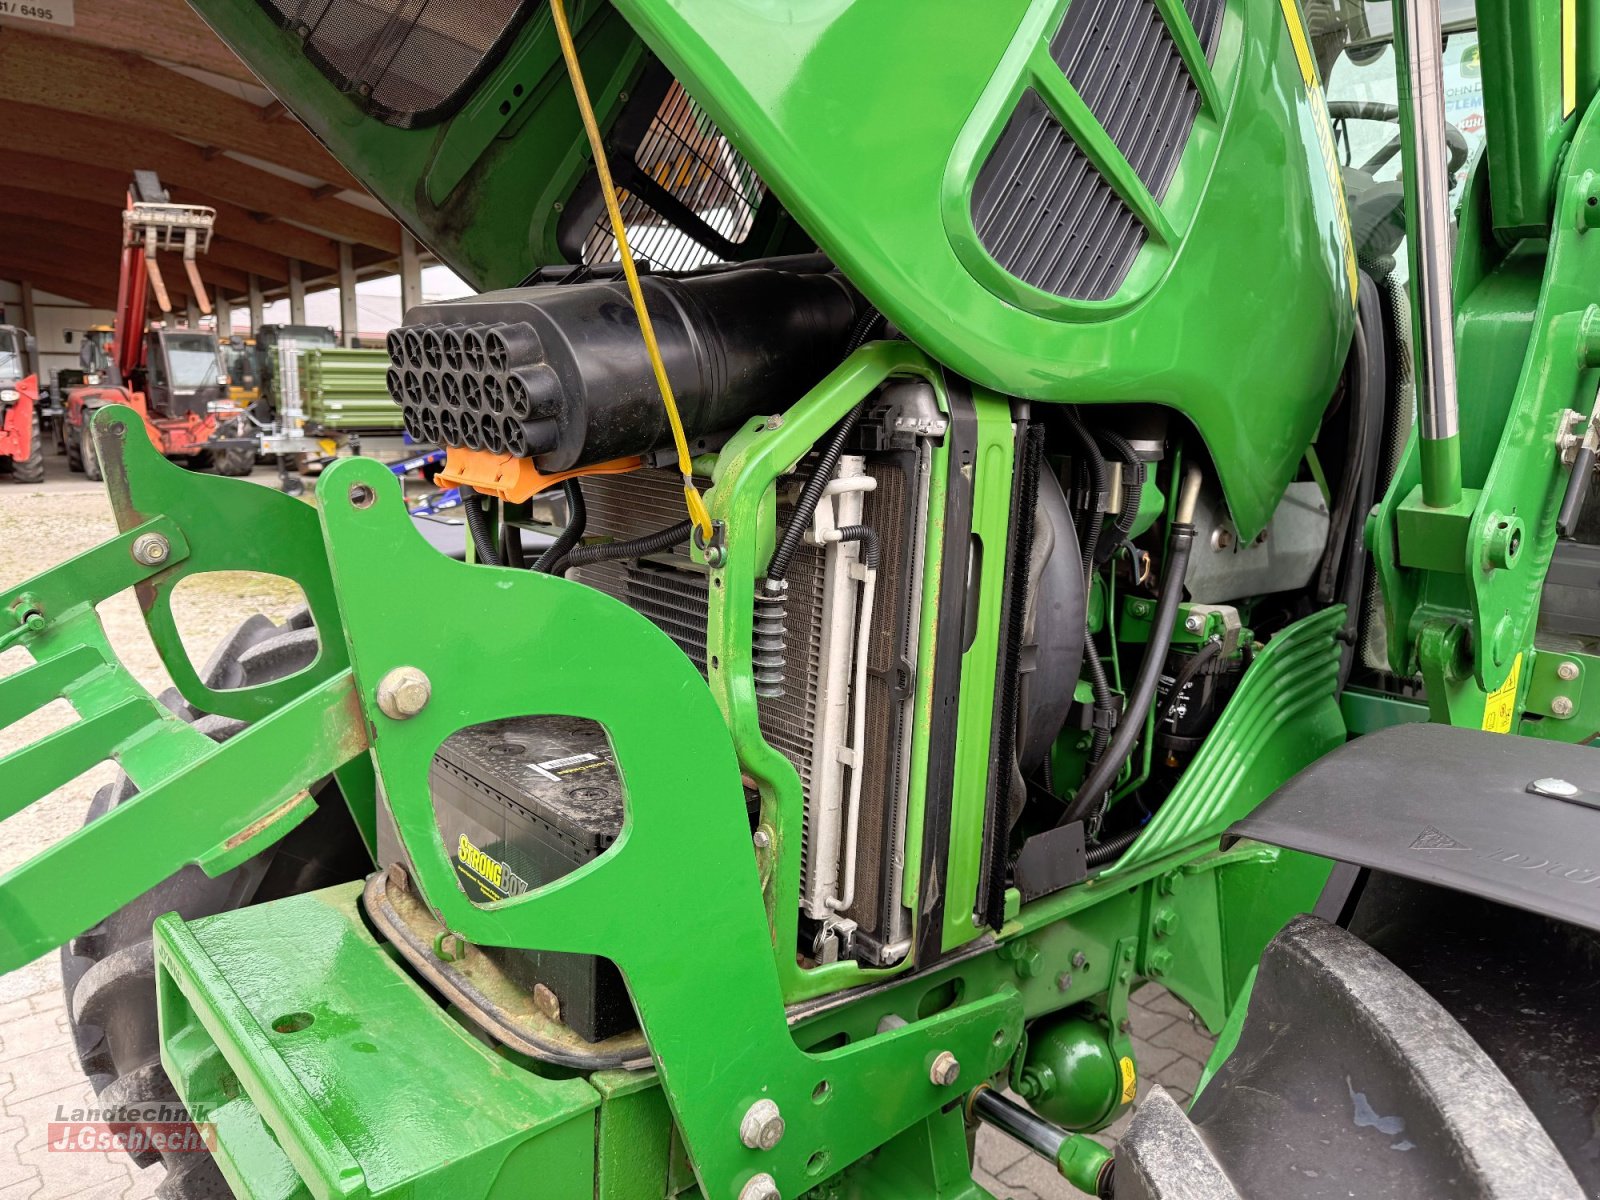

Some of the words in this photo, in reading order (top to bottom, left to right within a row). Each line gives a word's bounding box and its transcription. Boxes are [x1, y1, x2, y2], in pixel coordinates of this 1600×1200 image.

[20, 4, 53, 20] 6495
[1446, 84, 1472, 97] OHN
[1455, 96, 1482, 110] LEM
